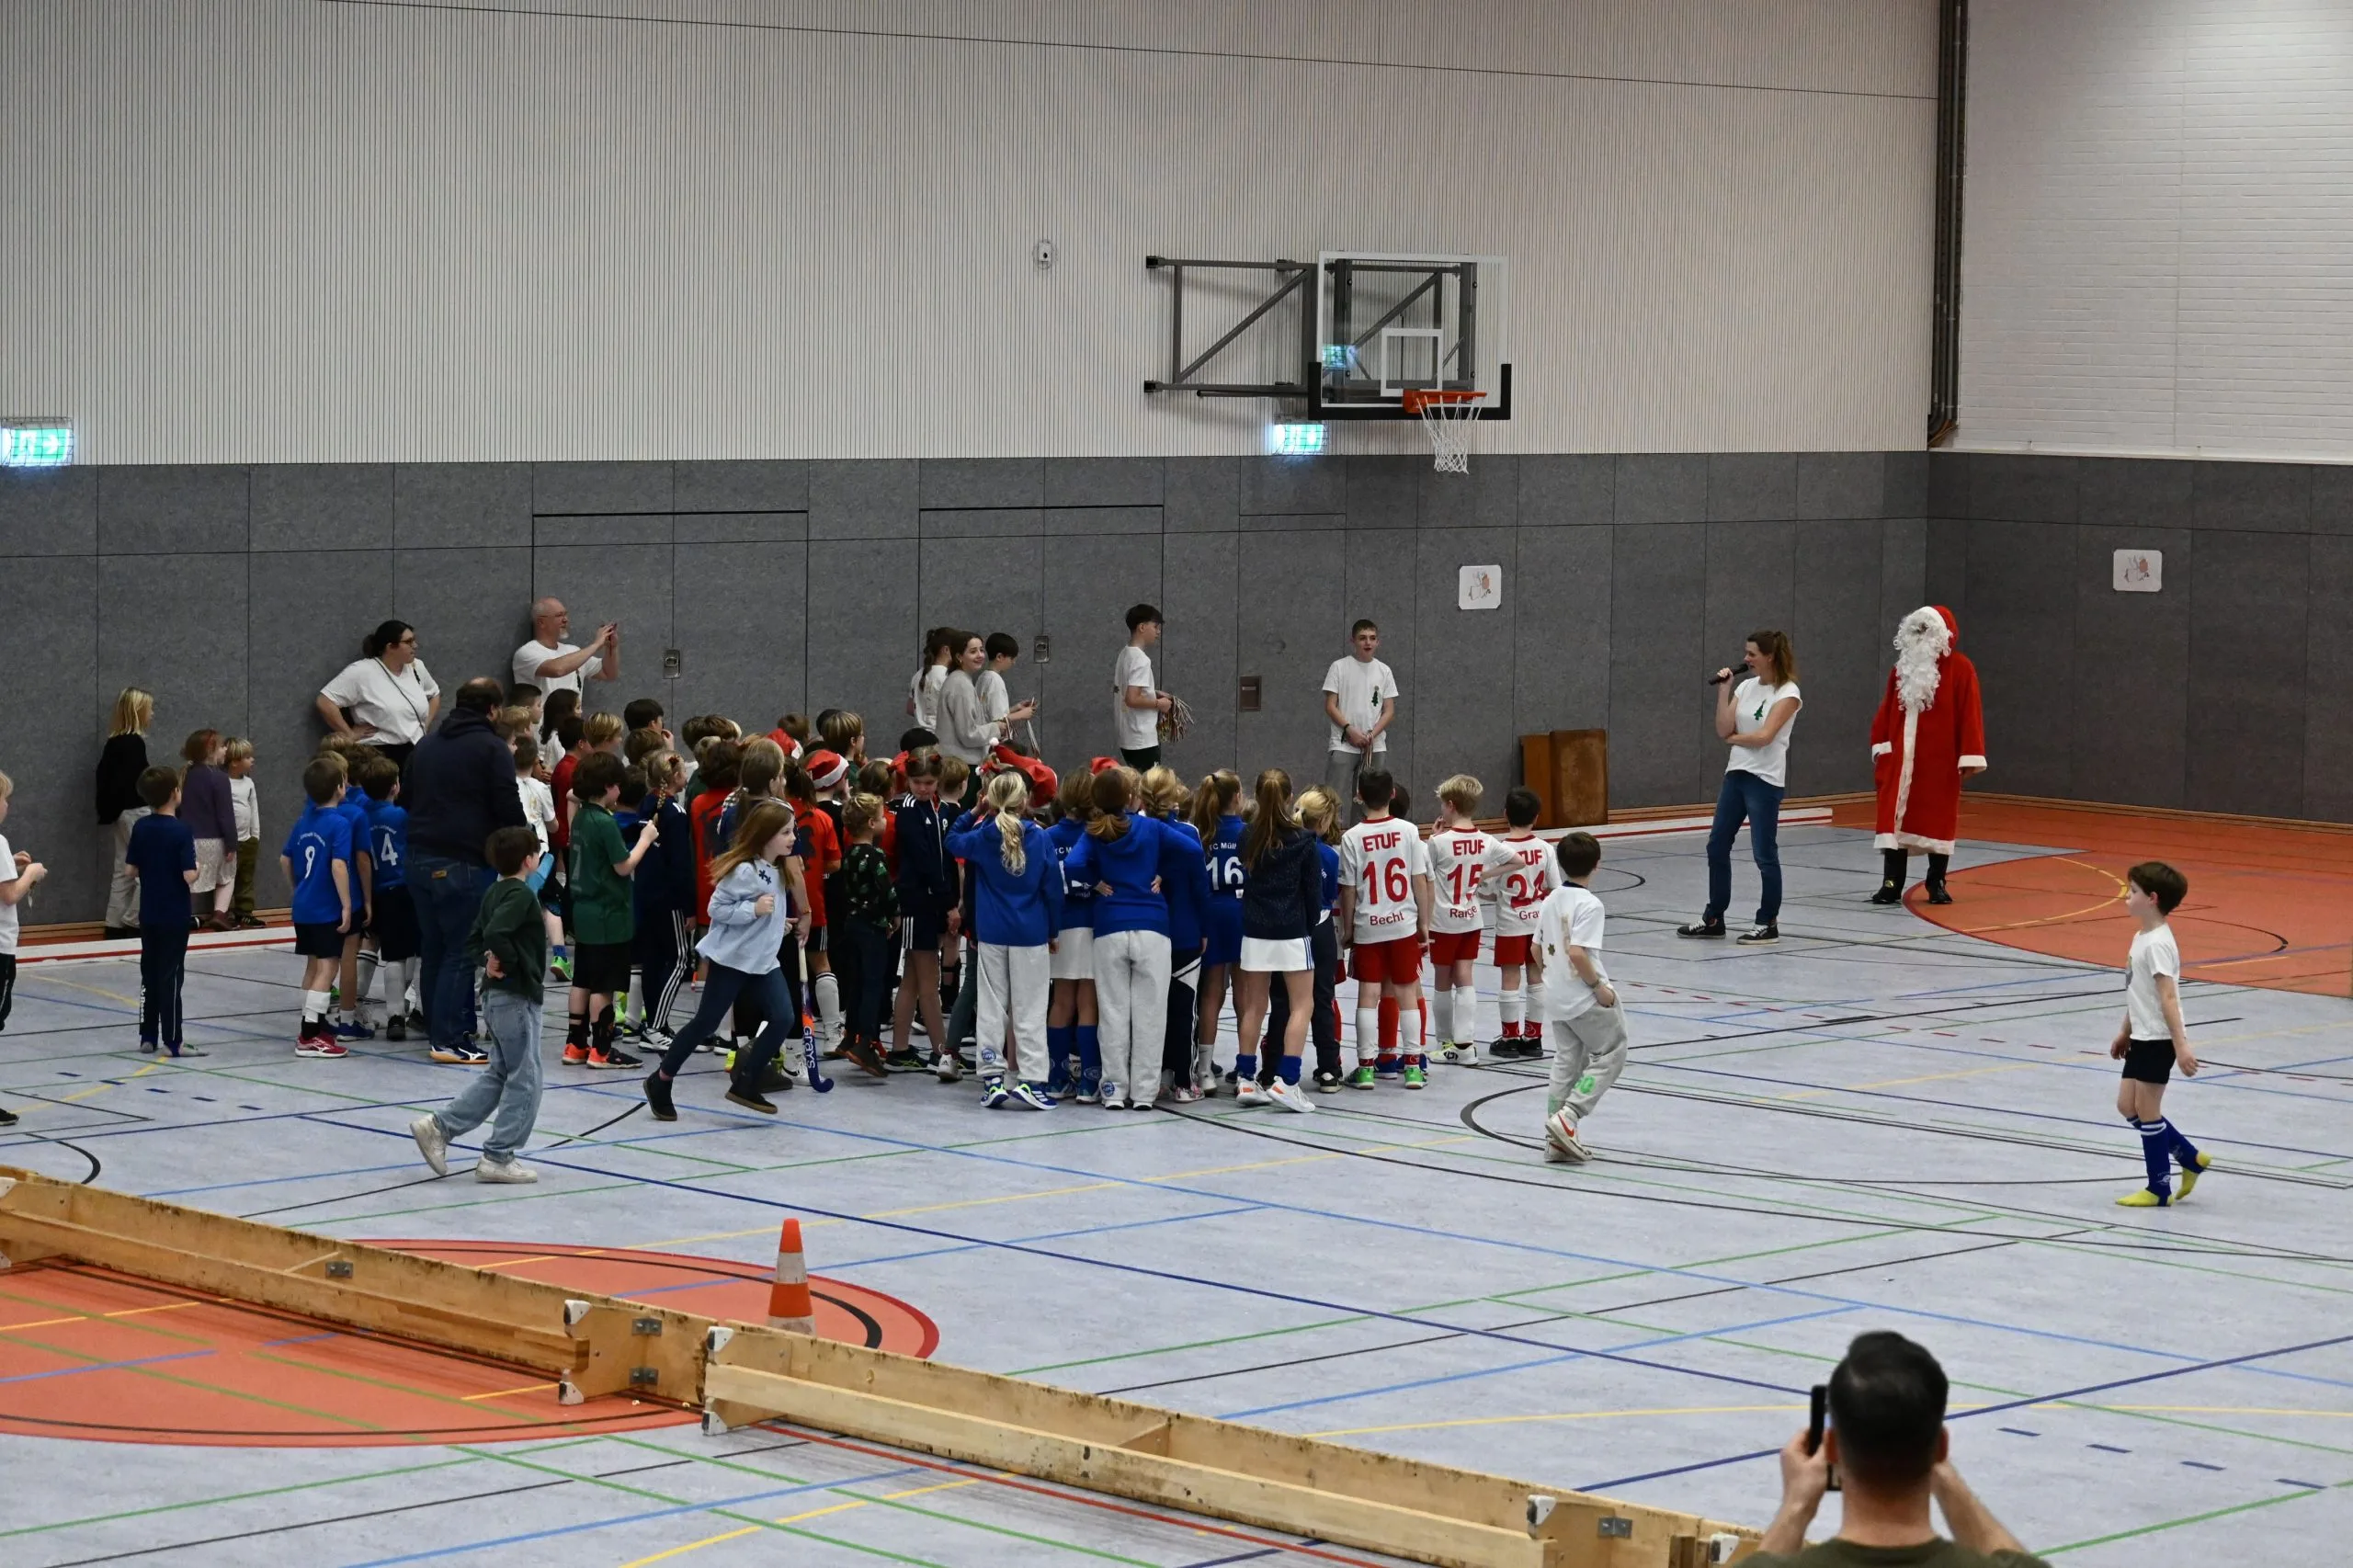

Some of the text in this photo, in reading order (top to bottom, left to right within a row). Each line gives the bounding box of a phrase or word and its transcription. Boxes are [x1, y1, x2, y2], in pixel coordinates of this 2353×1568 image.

[1362, 832, 1401, 852] ETUF
[1452, 839, 1485, 857] ETUF
[1205, 856, 1245, 899] 16
[1362, 857, 1408, 905] 16
[1370, 911, 1405, 926] Becht
